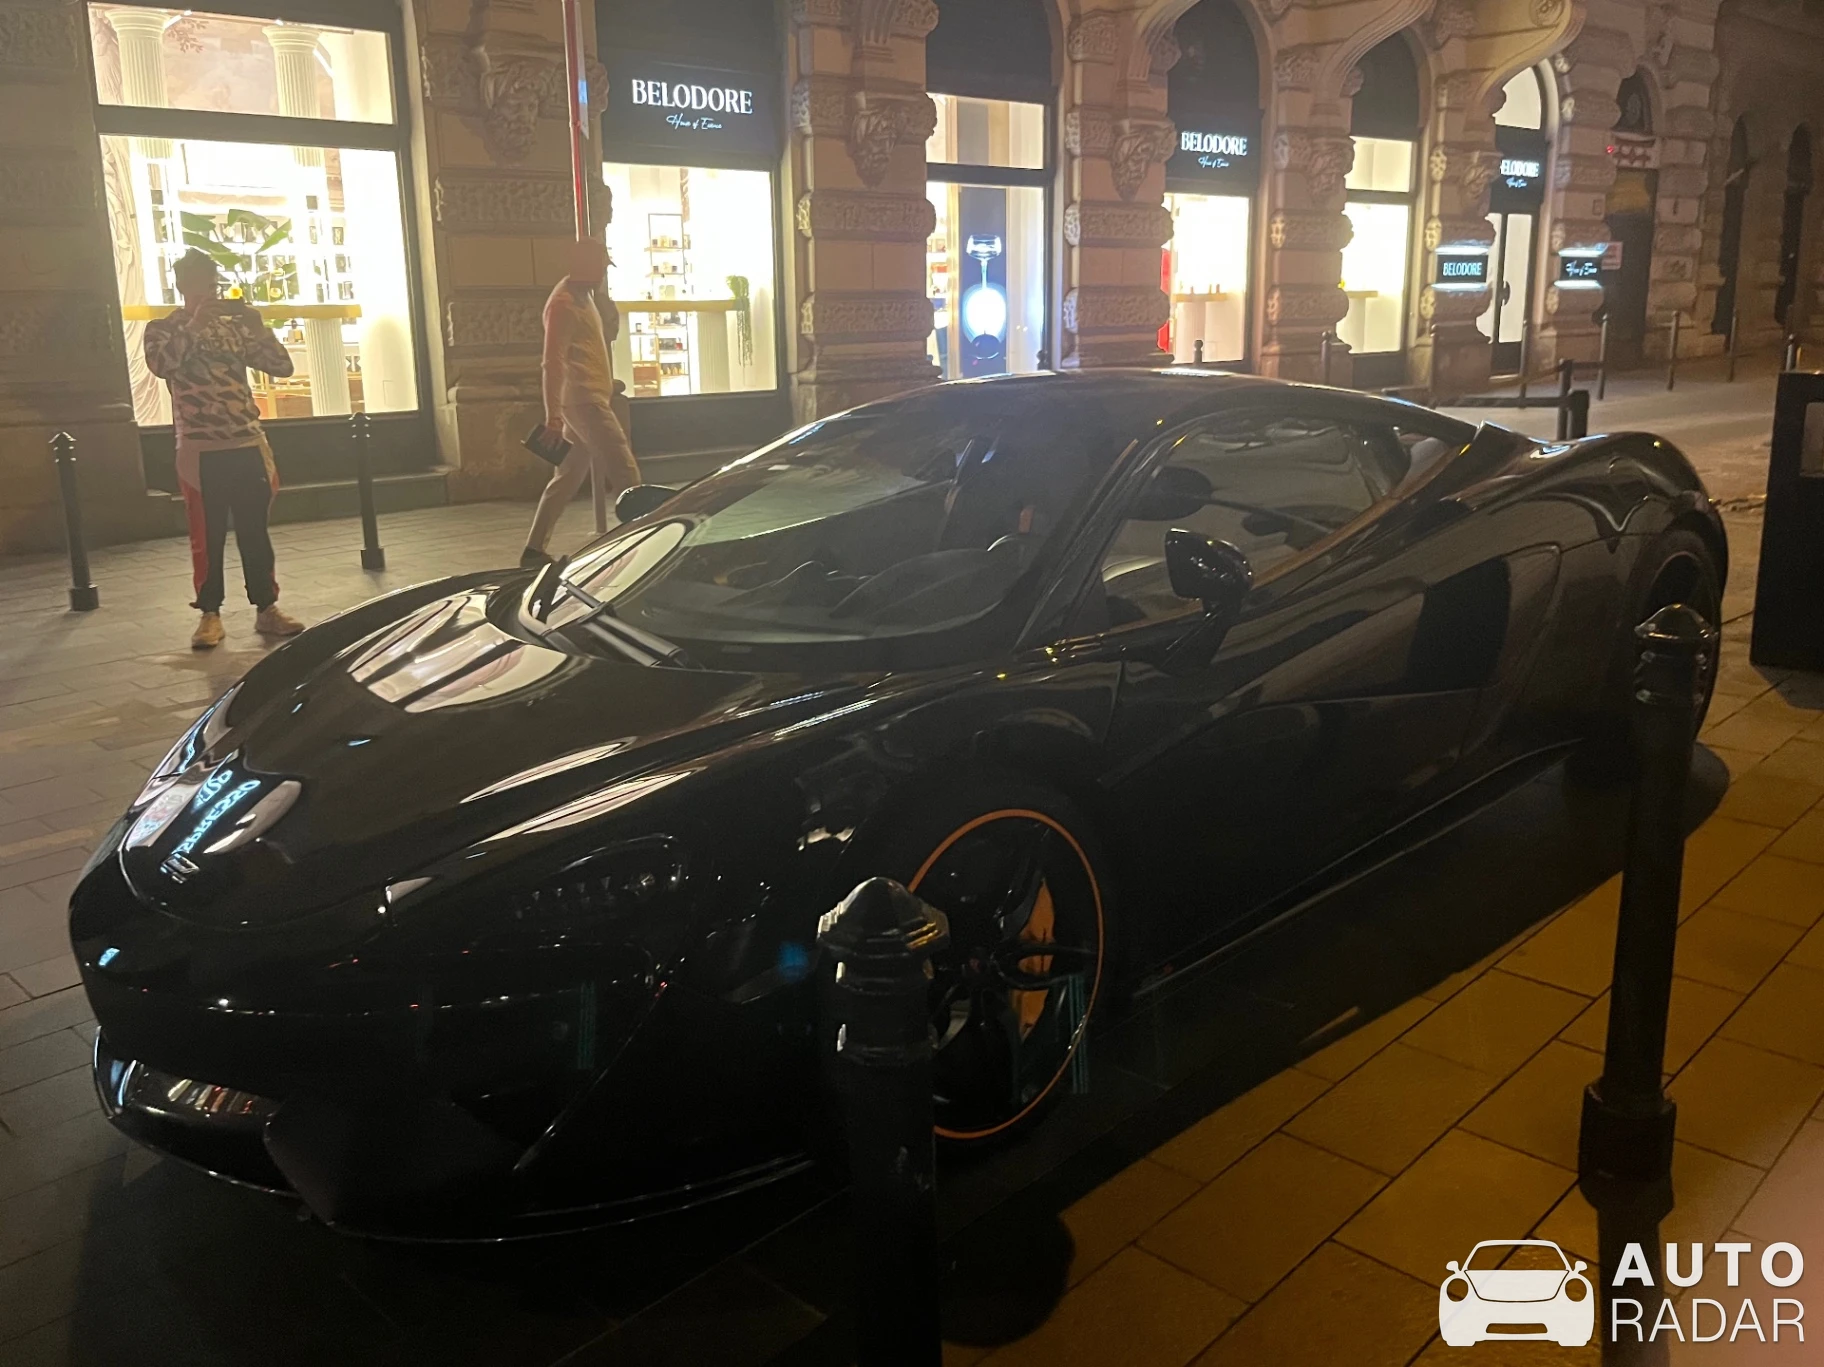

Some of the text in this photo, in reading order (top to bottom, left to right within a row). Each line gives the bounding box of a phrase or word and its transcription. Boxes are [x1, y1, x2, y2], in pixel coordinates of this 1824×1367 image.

[632, 79, 753, 114] BELODORE
[1181, 132, 1247, 156] BELODORE
[1443, 262, 1482, 276] BELODORE
